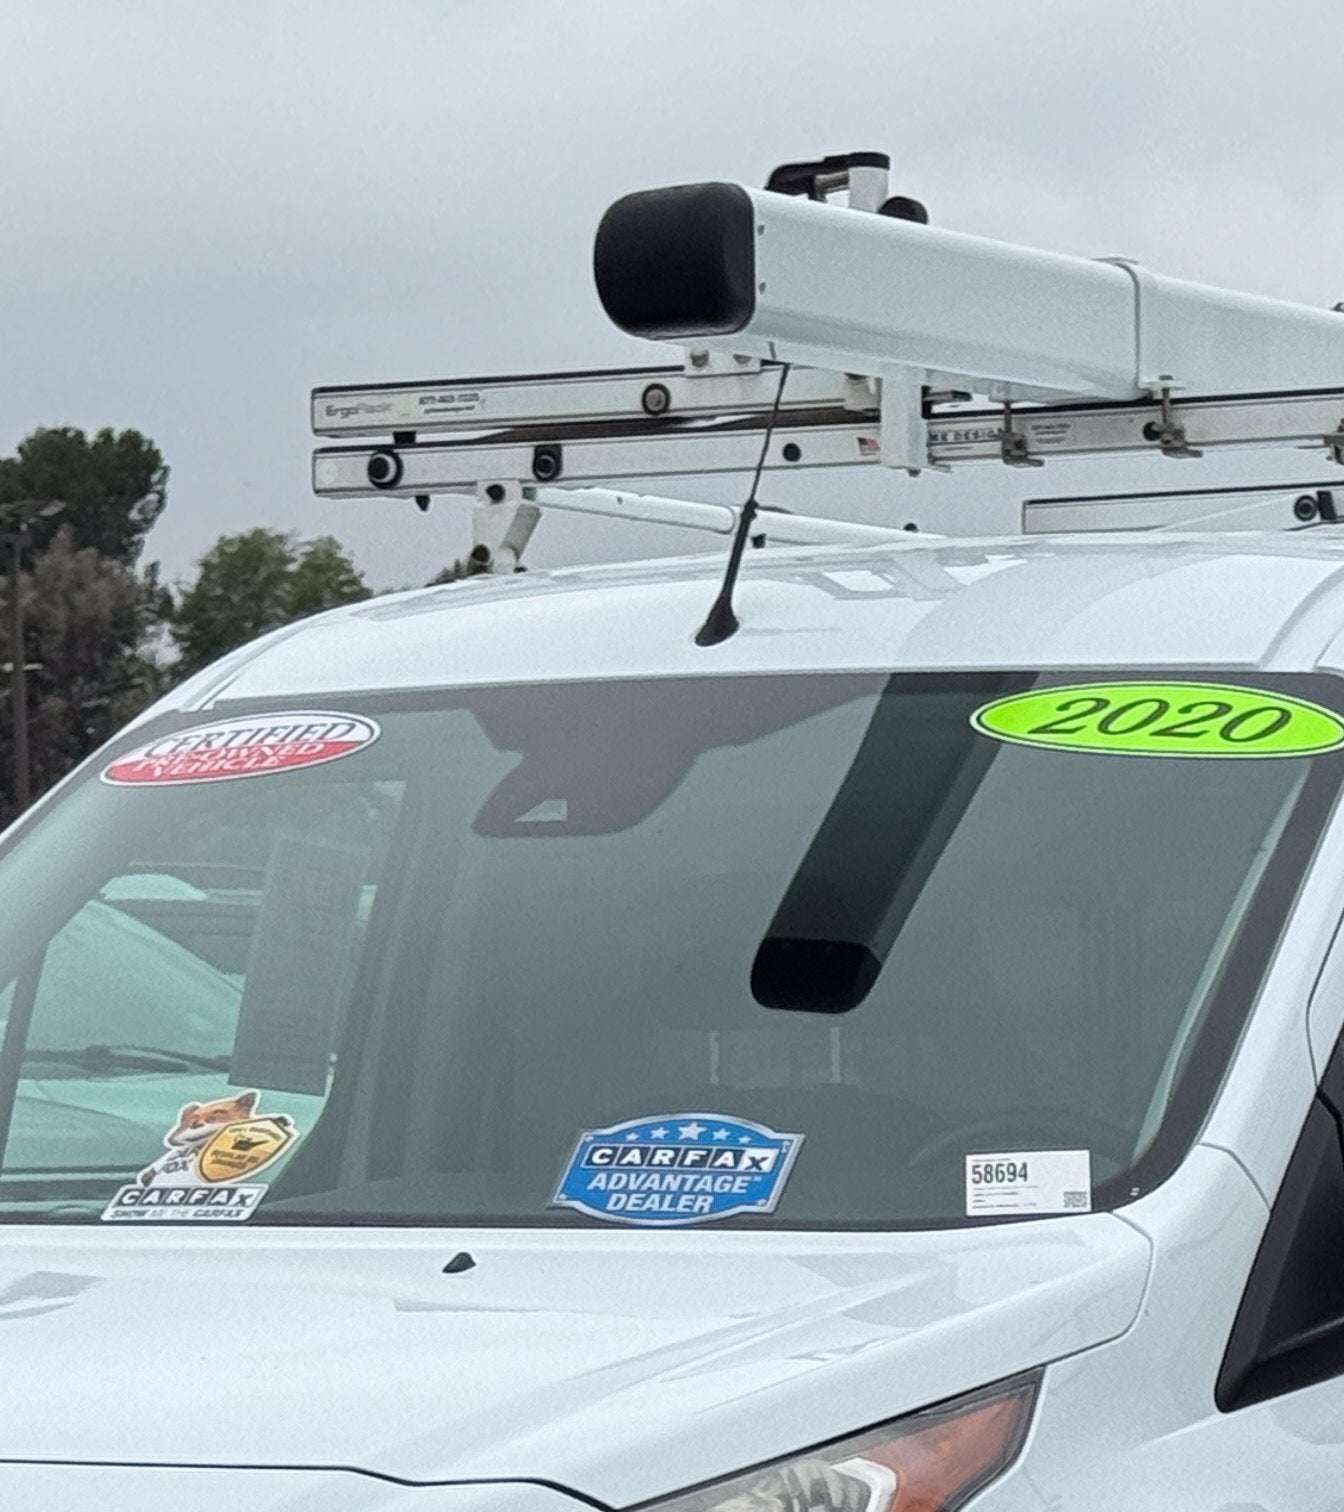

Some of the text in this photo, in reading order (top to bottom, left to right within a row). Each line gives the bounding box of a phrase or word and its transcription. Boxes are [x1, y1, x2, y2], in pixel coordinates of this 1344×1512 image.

[1026, 696, 1293, 744] 2020
[144, 722, 357, 758] CERTIFIED
[153, 754, 288, 778] VEHICLE
[591, 1147, 770, 1171] CARFAX
[586, 1172, 752, 1194] ADVANTAGE
[971, 1161, 1029, 1185] 58694
[122, 1189, 255, 1208] CARFAX
[605, 1193, 714, 1214] DEALER
